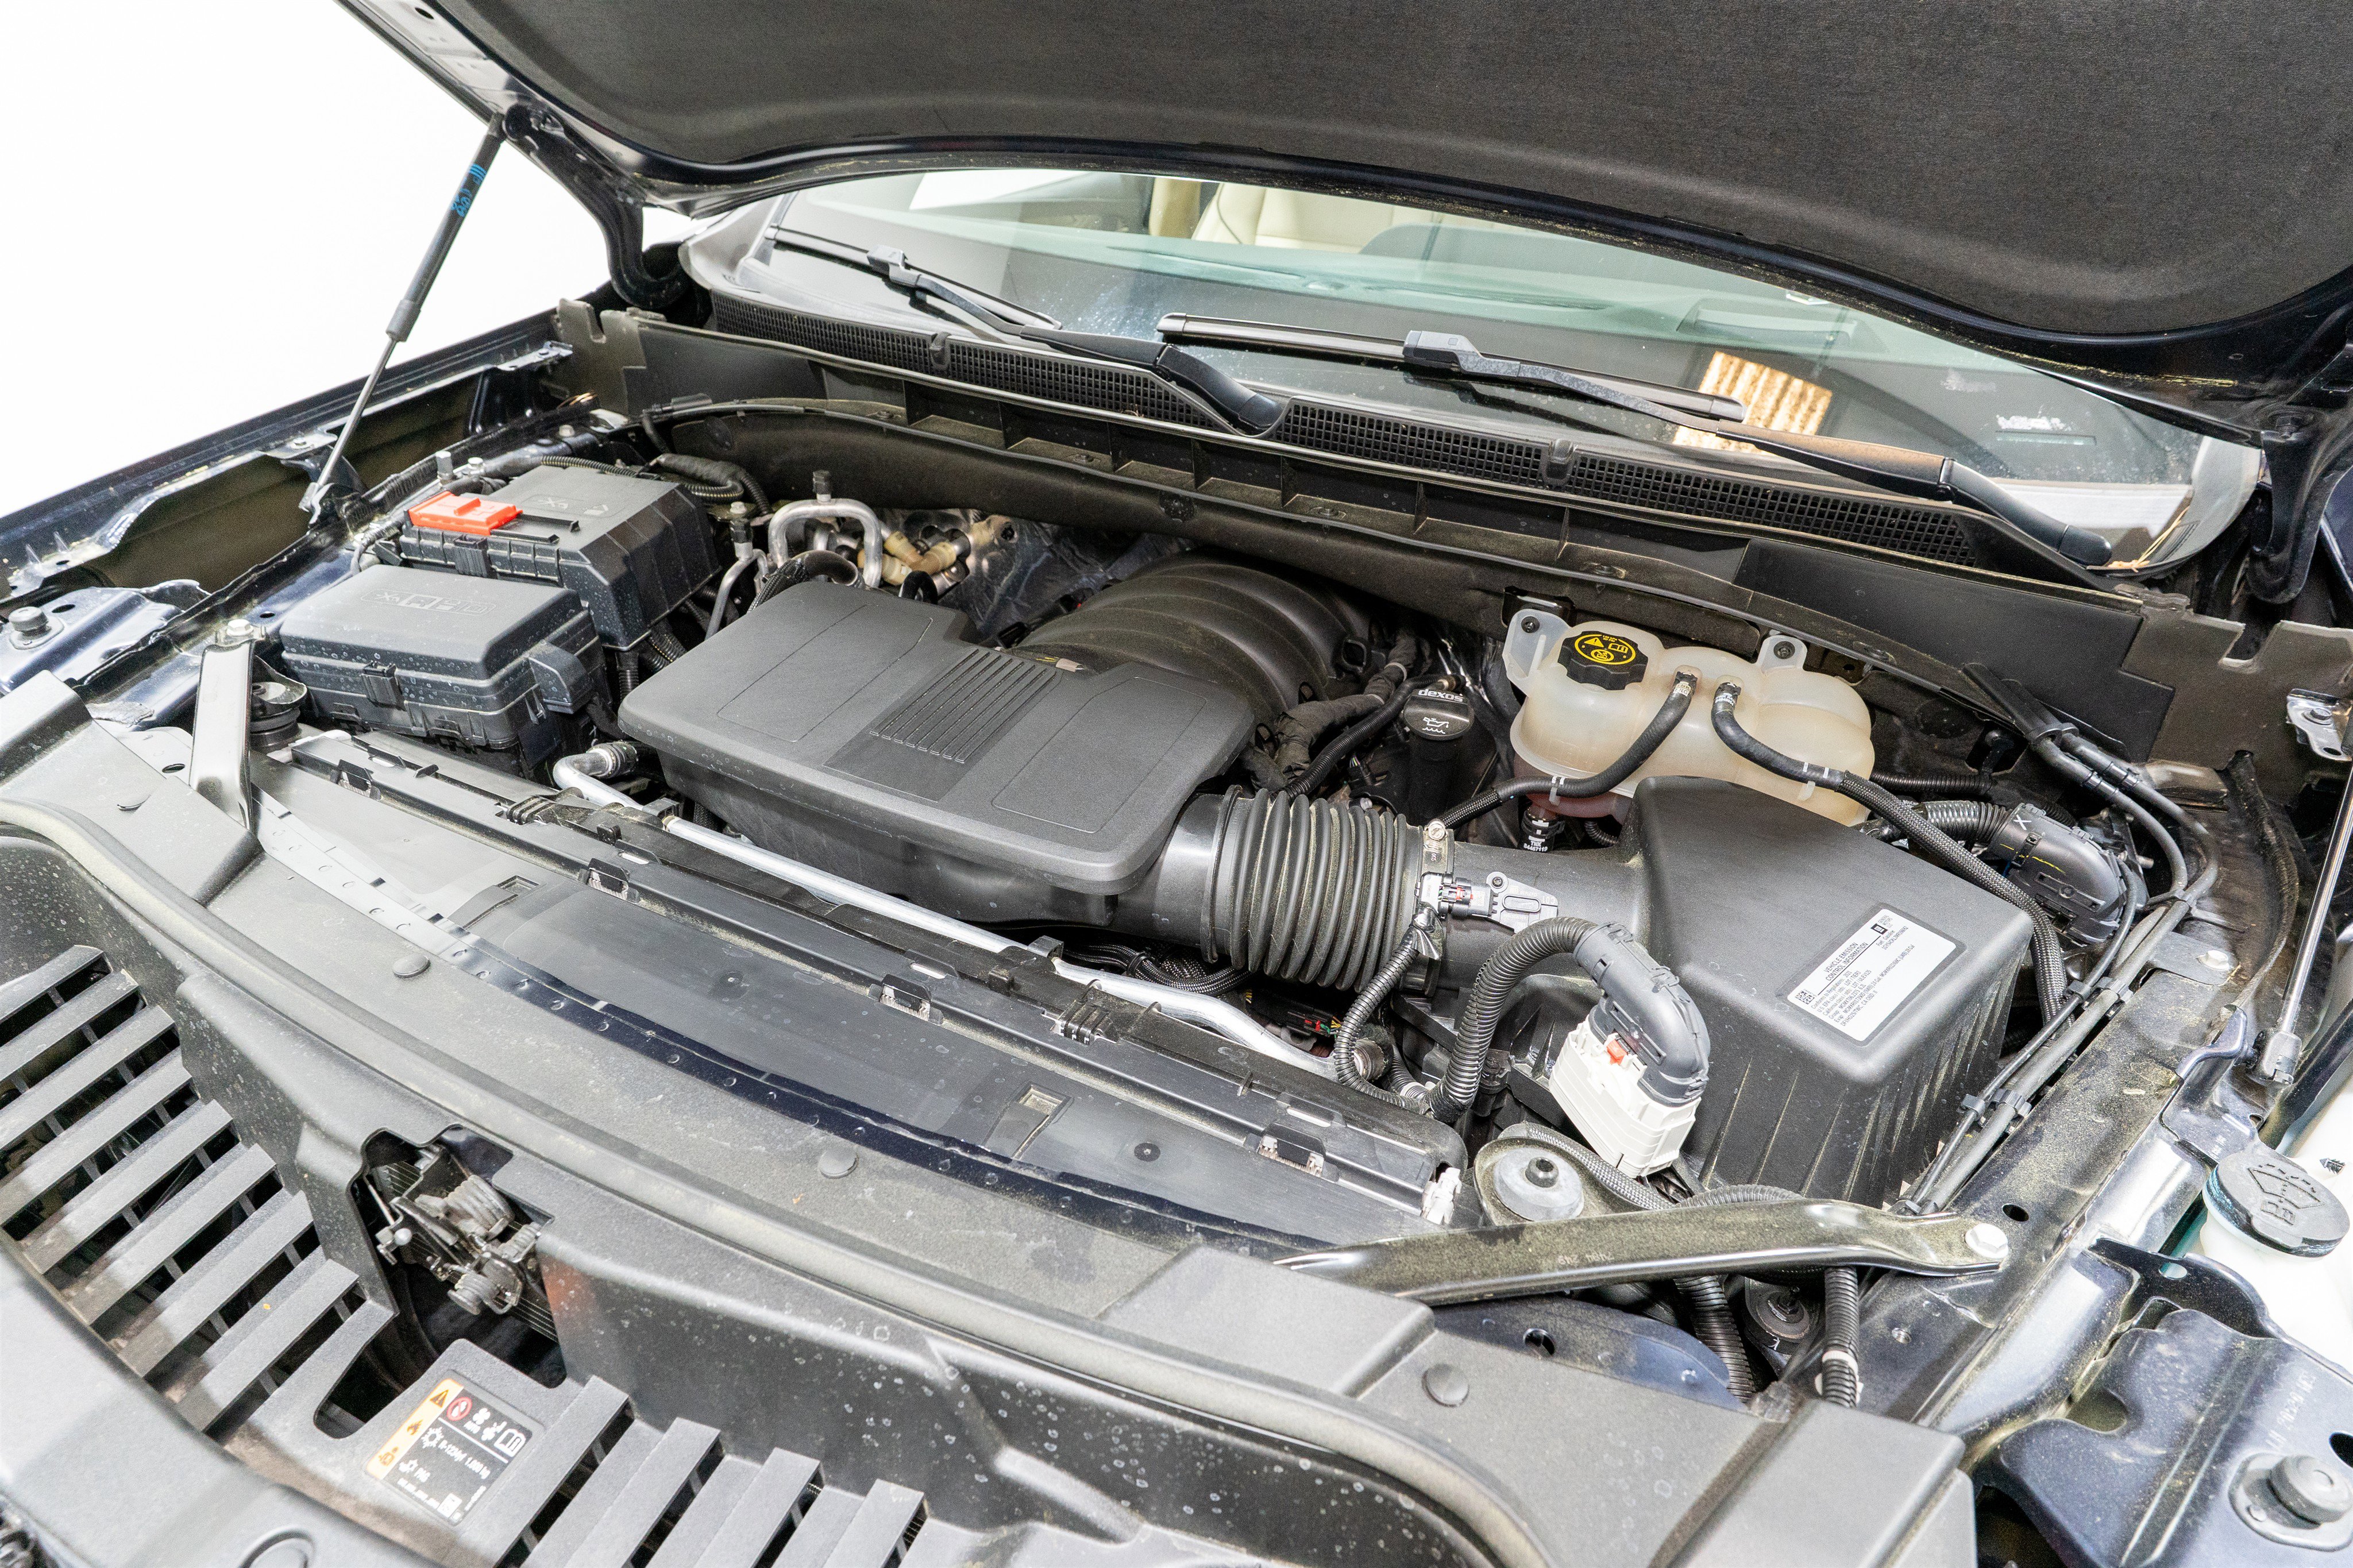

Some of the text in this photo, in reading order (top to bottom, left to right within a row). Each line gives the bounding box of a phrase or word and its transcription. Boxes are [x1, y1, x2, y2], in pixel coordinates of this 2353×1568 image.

[1418, 689, 1463, 702] dexos
[1823, 941, 1858, 973] VEHICLE EMISSION
[1824, 941, 1869, 981] CONTROL INFORMATION
[1810, 995, 1826, 1009] Conforms
[1822, 1002, 1838, 1016] California
[1835, 995, 1845, 1003] class
[1828, 993, 1838, 1001] class
